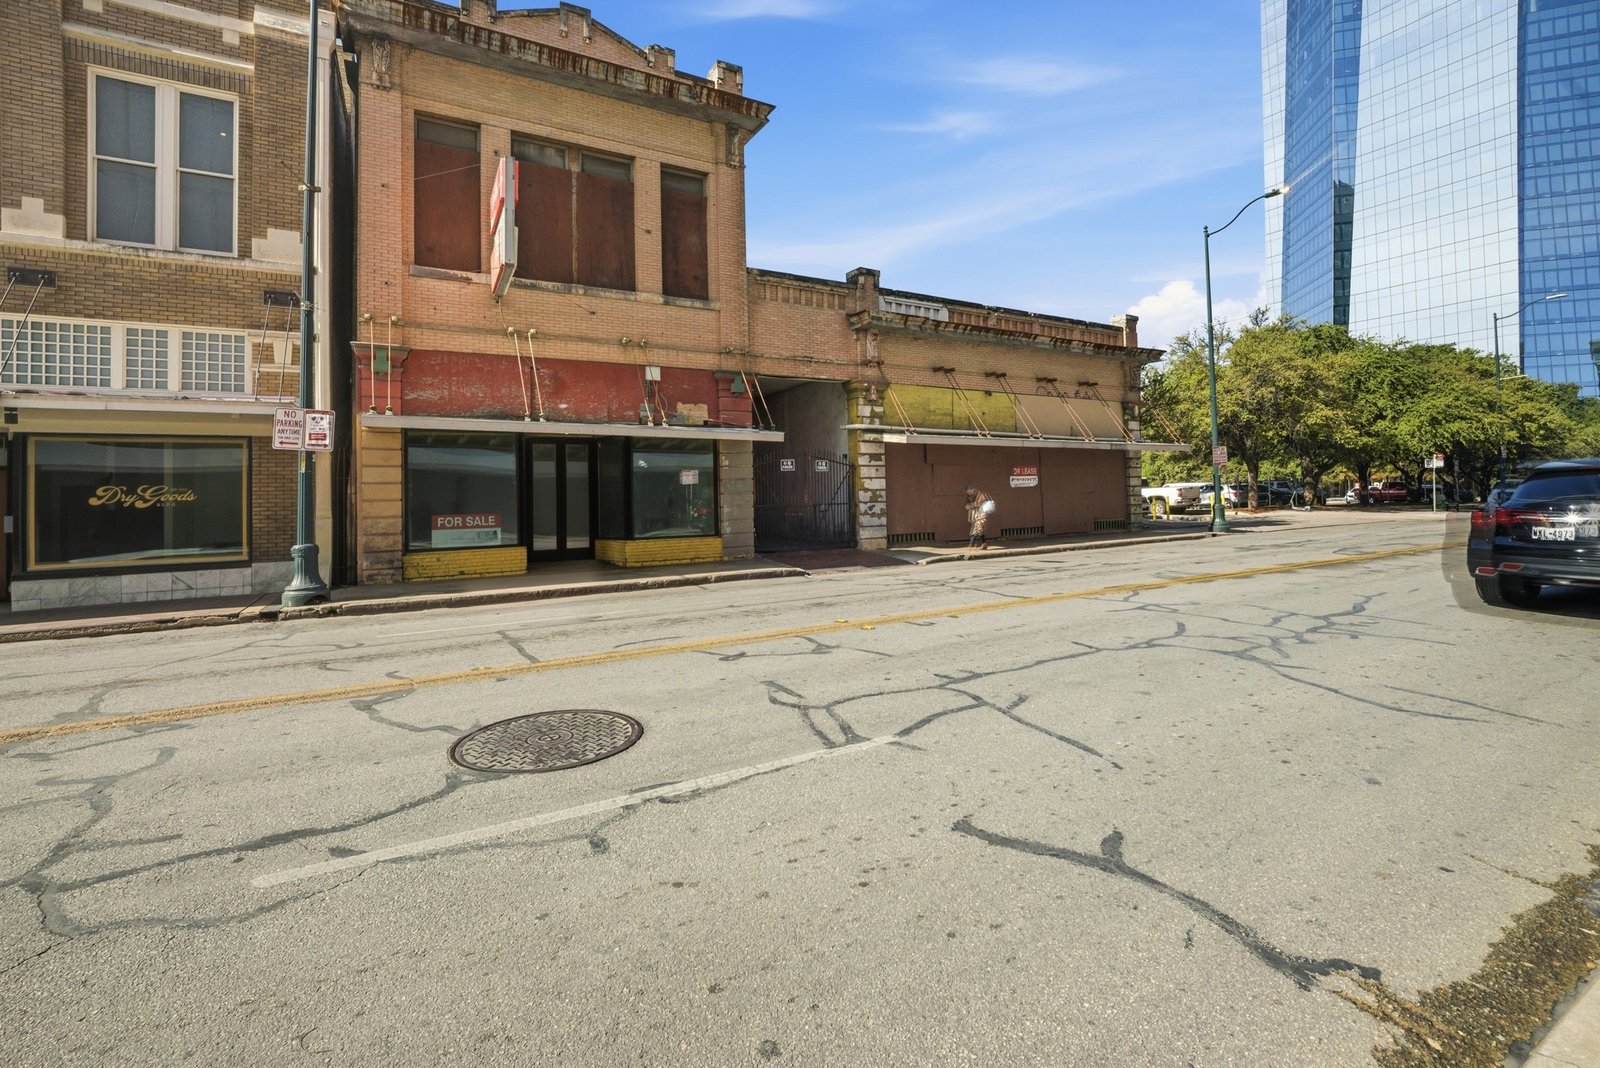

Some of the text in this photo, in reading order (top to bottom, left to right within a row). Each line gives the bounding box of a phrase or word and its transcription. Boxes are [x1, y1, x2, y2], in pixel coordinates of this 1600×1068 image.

[283, 410, 297, 419] NO
[276, 419, 303, 429] PARKING
[277, 428, 301, 436] ANYTIME
[88, 485, 197, 509] Dry Goods
[437, 515, 496, 528] FOR SALE
